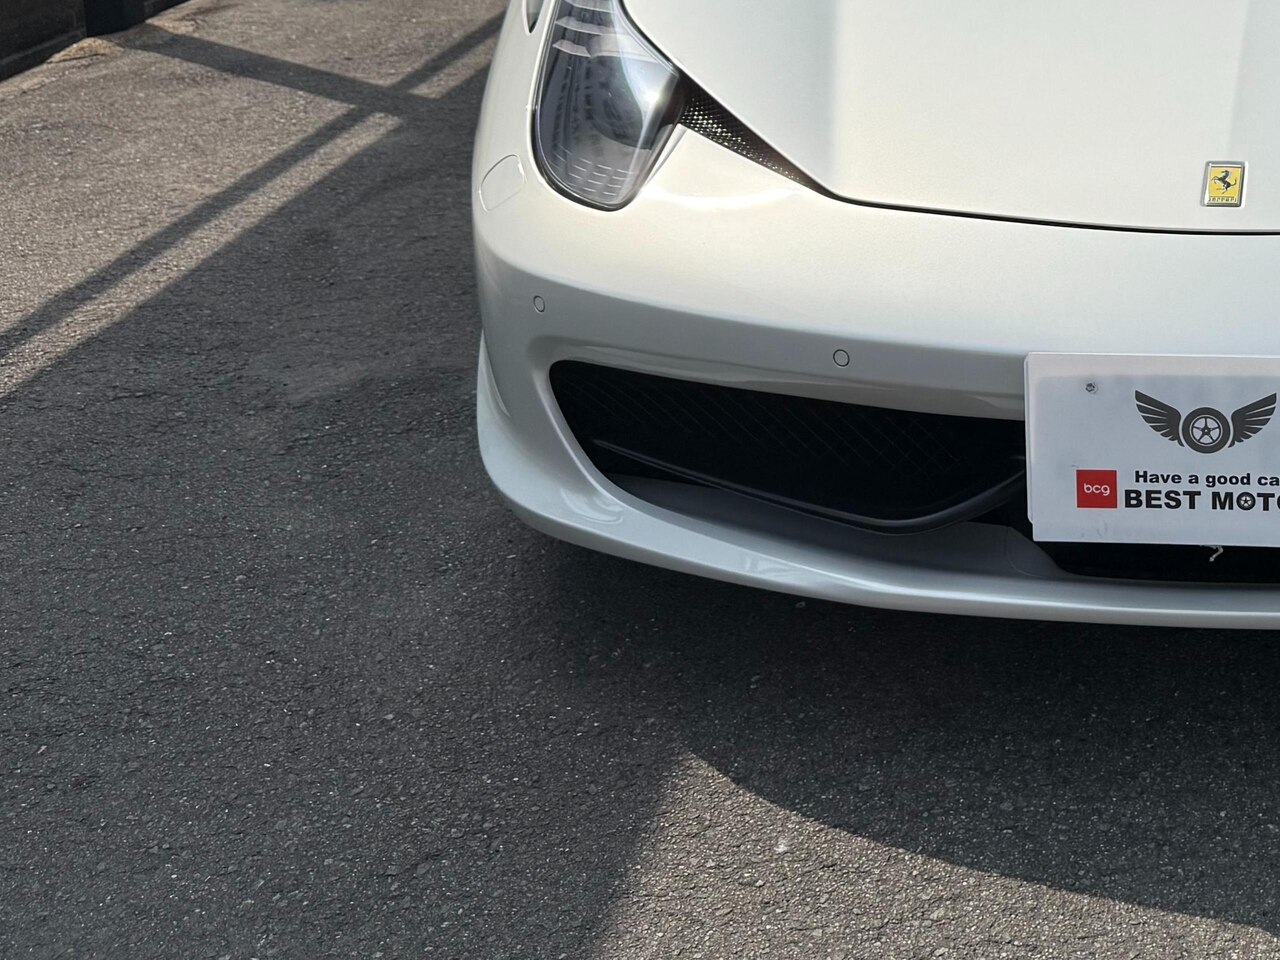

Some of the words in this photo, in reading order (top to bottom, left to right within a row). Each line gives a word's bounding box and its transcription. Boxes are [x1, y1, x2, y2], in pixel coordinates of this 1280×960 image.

[1135, 470, 1182, 484] Have
[1188, 474, 1199, 484] a
[1205, 473, 1251, 488] good
[1083, 483, 1110, 496] bcg
[1124, 489, 1202, 510] BEST
